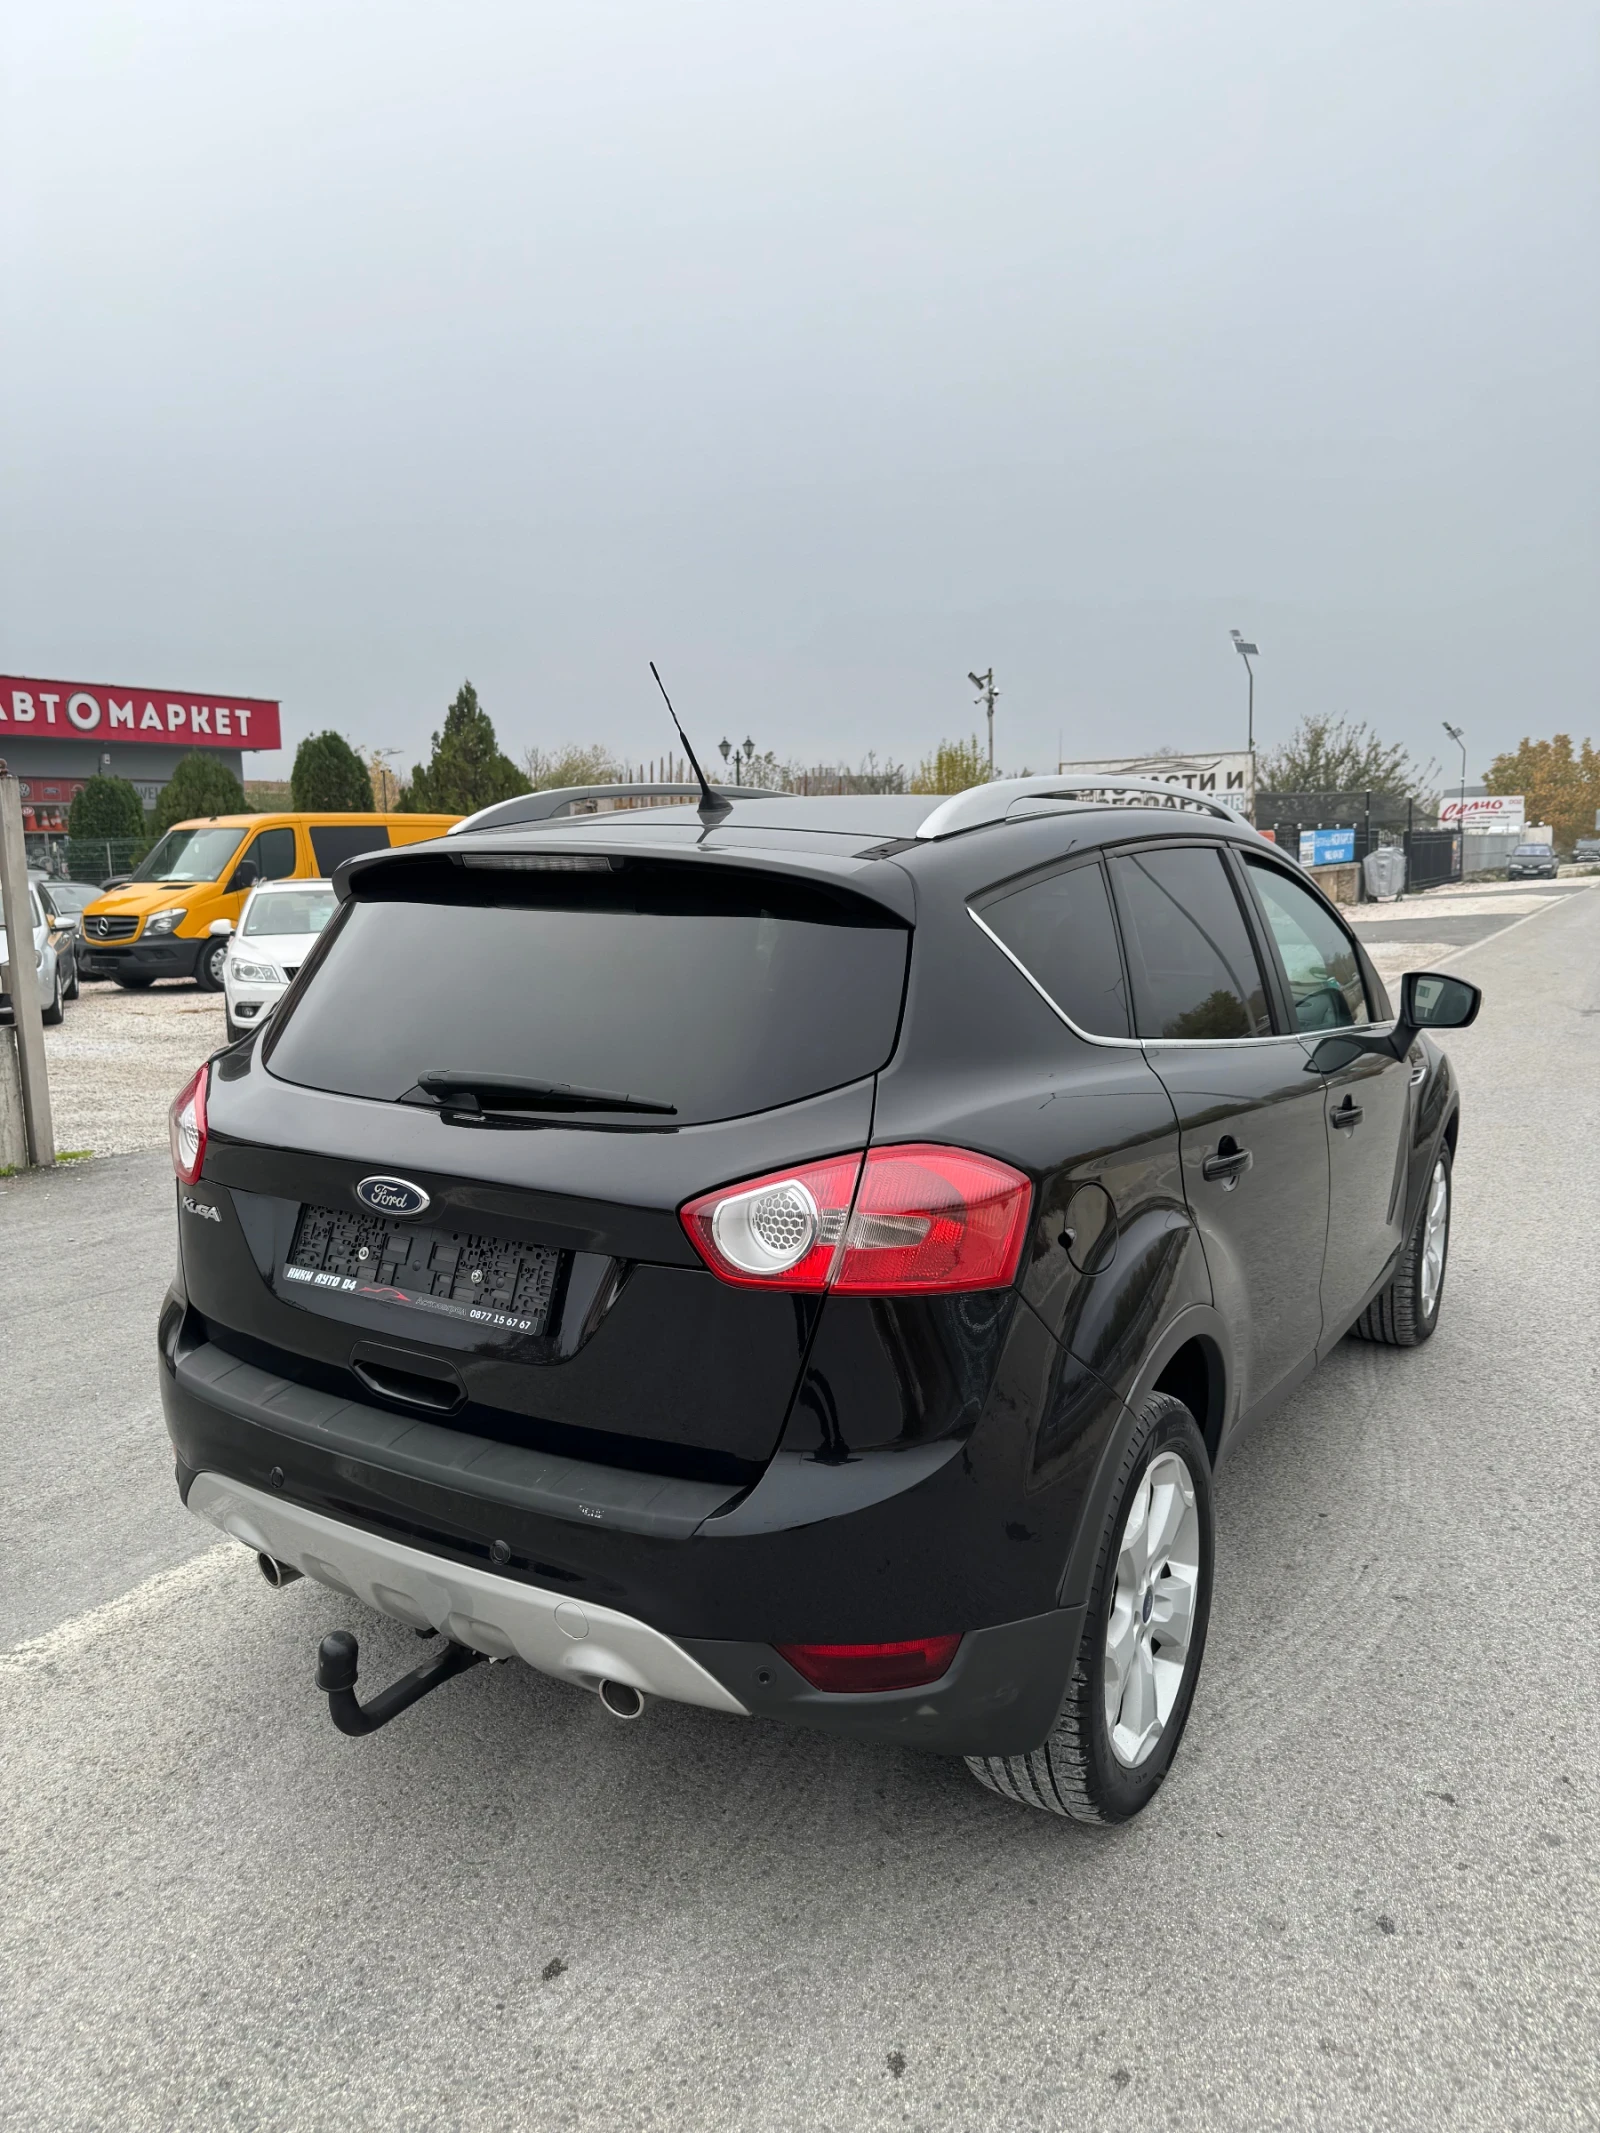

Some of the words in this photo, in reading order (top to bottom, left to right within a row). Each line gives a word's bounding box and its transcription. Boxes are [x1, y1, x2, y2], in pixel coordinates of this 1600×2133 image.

[1226, 771, 1244, 789] И
[371, 1183, 408, 1208] Ford
[182, 1196, 222, 1222] KUGA
[469, 1309, 492, 1321] 0877
[493, 1314, 505, 1324] 15
[506, 1317, 518, 1327] 67
[519, 1320, 531, 1330] 67
